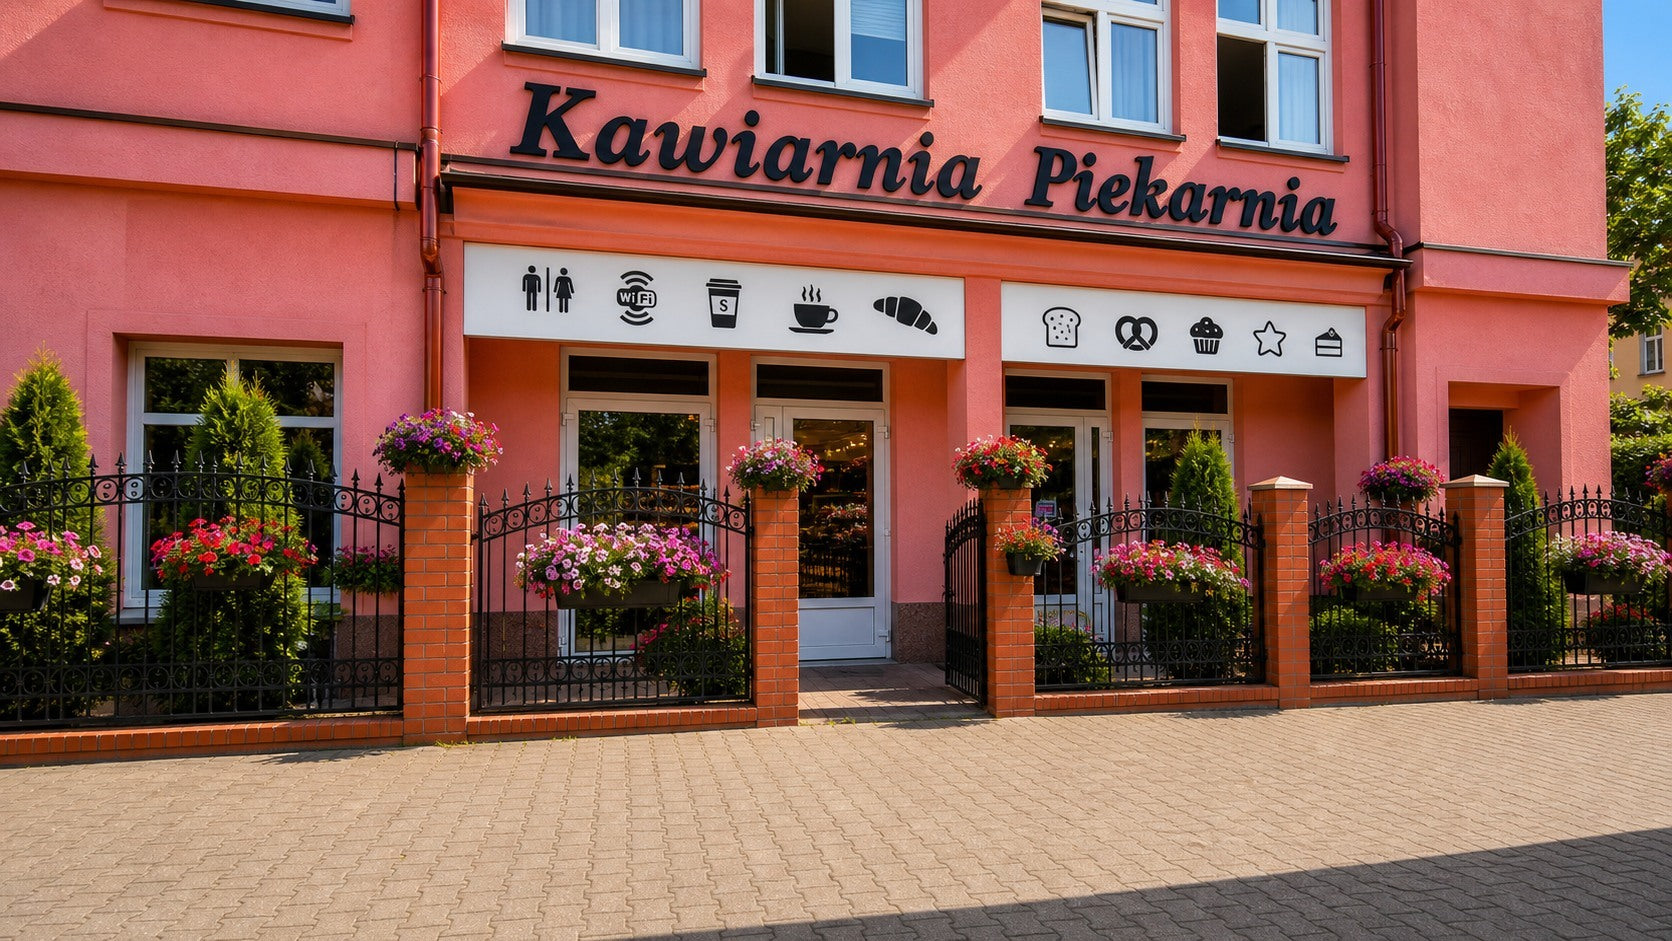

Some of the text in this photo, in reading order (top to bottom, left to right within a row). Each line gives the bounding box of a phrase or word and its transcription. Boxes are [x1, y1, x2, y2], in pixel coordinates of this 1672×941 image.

[509, 81, 1338, 237] Kawiarnia Piekarnia
[719, 298, 728, 313] S
